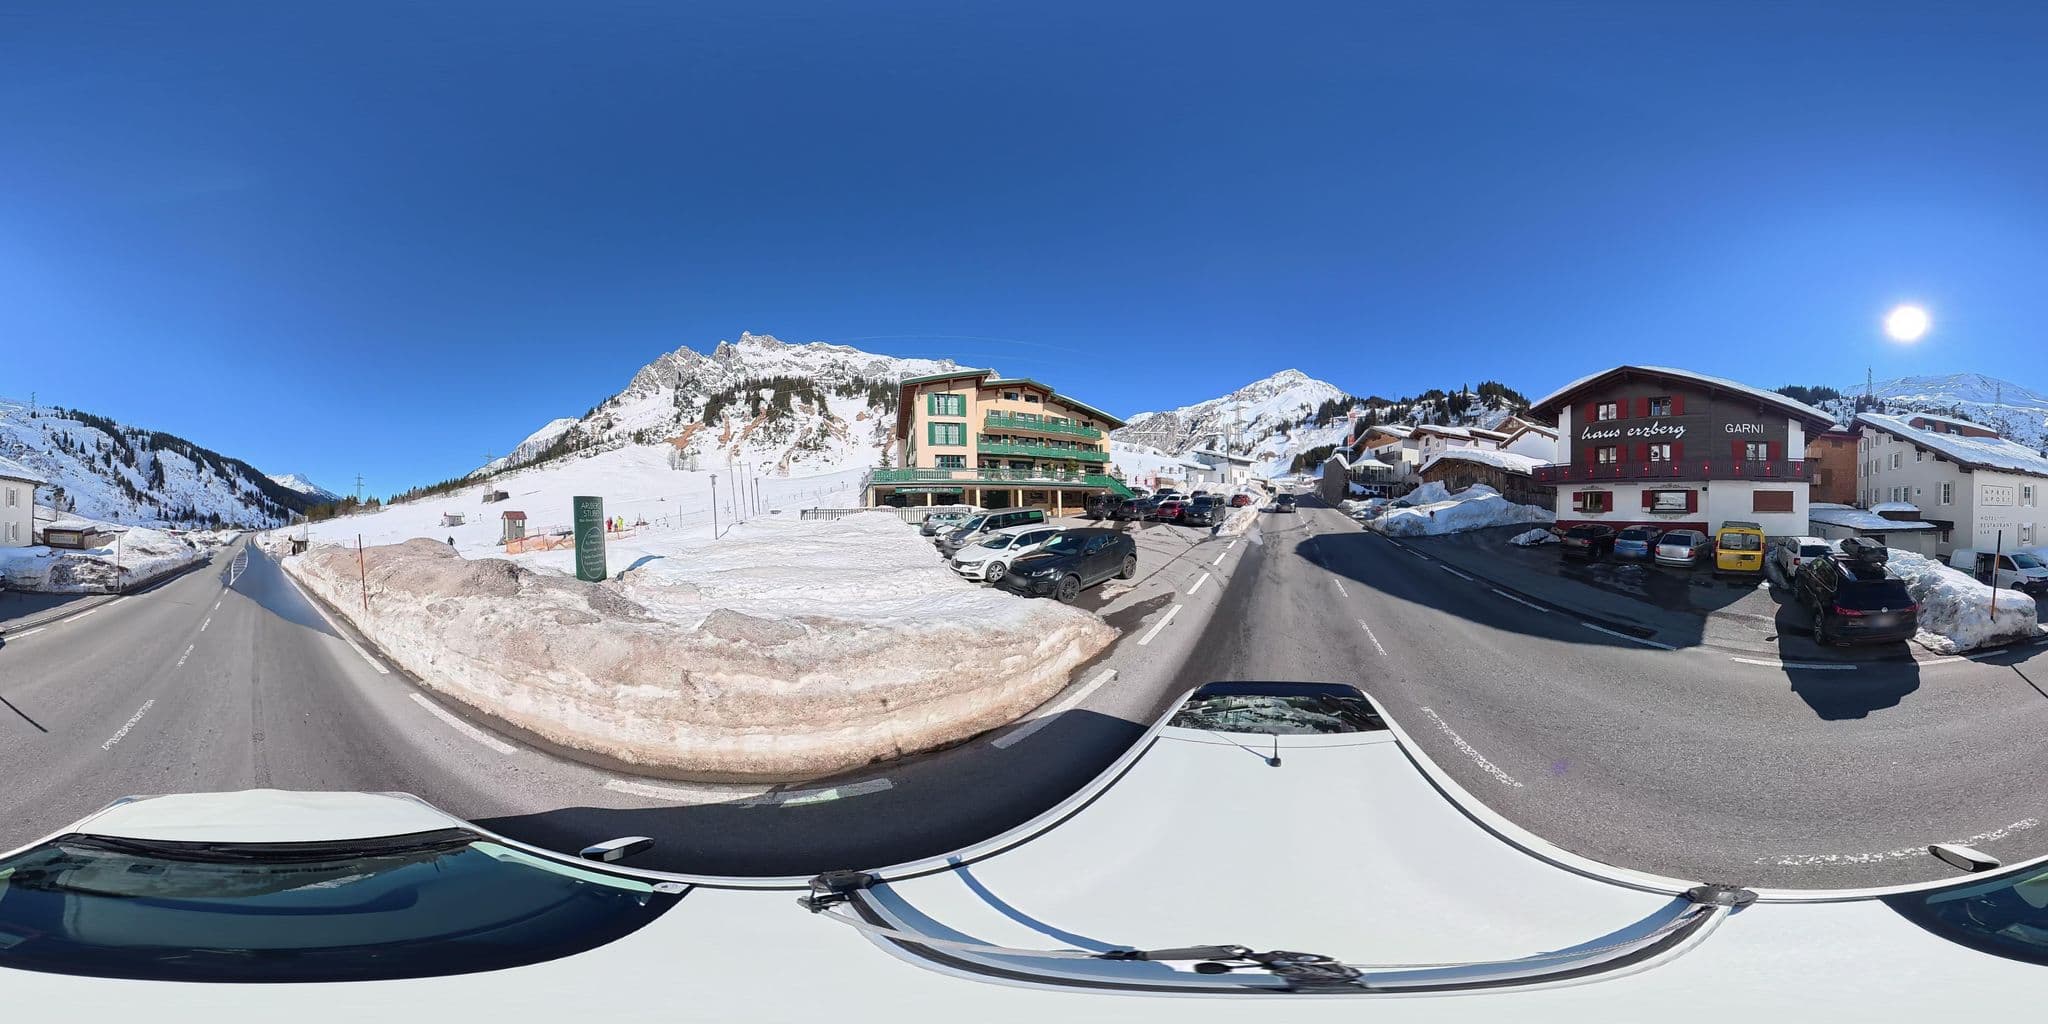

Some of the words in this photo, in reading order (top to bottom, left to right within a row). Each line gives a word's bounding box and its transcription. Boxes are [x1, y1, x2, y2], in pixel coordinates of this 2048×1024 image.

[1581, 426, 1620, 440] haus
[1627, 421, 1687, 439] erzberg
[1725, 423, 1764, 434] GARNI
